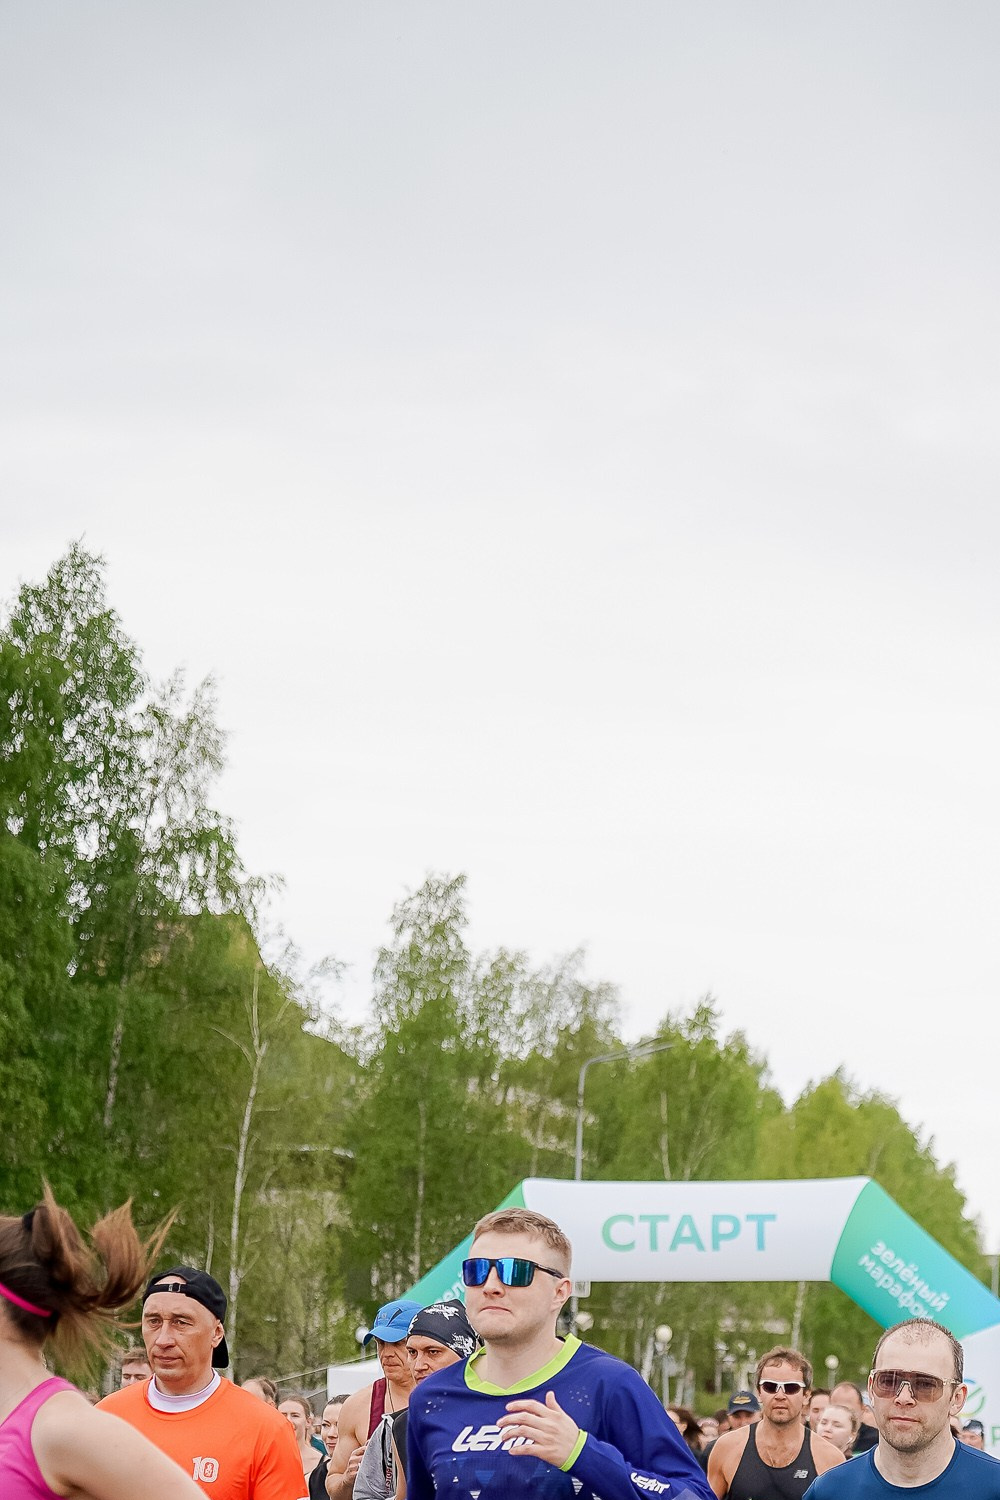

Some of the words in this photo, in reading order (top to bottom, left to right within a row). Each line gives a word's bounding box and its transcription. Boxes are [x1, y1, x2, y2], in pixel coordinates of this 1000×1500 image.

[601, 1213, 777, 1252] СТАРТ
[870, 1240, 949, 1312] зелёный
[192, 1457, 219, 1483] 10
